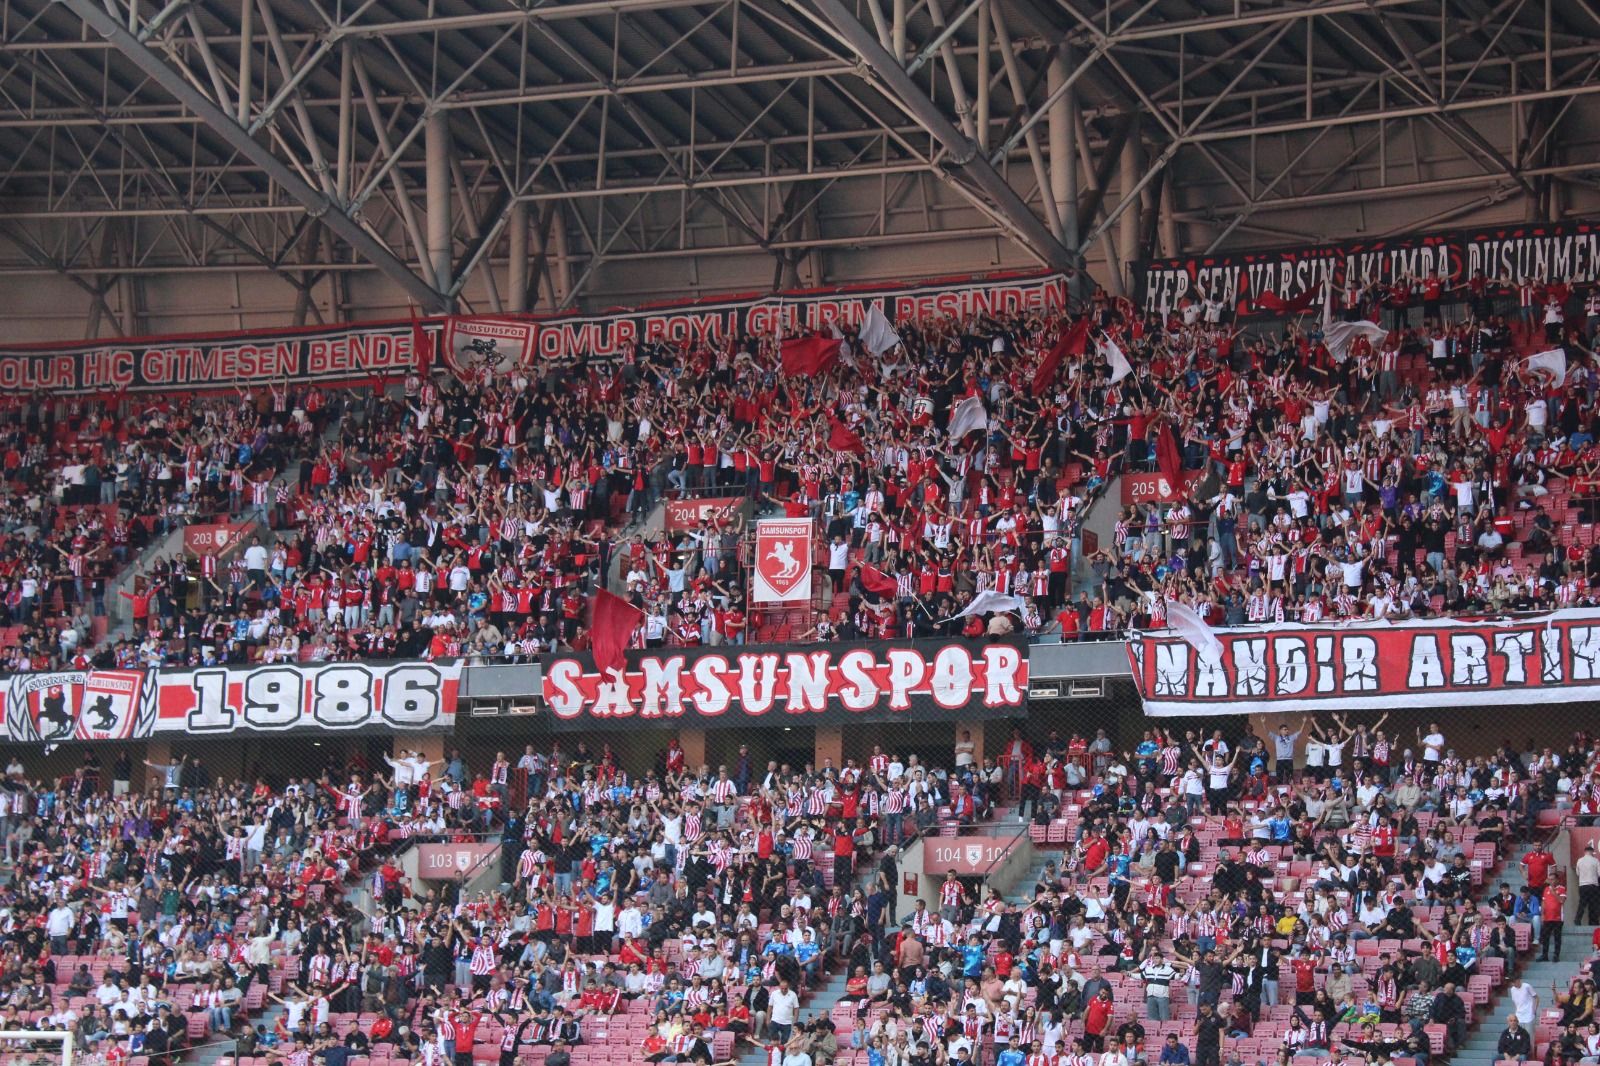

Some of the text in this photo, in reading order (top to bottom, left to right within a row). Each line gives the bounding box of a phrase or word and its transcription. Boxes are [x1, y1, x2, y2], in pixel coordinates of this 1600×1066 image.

[1145, 269, 1190, 313] HEP
[1197, 265, 1240, 312] SEN
[1248, 255, 1336, 310] VARSIN
[456, 322, 525, 337] SAMSUNSPOR
[0, 355, 76, 389] OLUR
[1131, 481, 1155, 496] 205
[674, 508, 696, 521] 204
[761, 526, 807, 535] SAMSUNSPOR
[192, 532, 212, 545] 203
[1405, 625, 1600, 690] ARTIK
[547, 643, 1024, 719] SAMSUNSPOR
[186, 663, 443, 735] 1986
[429, 854, 453, 868] 103
[935, 847, 961, 862] 104
